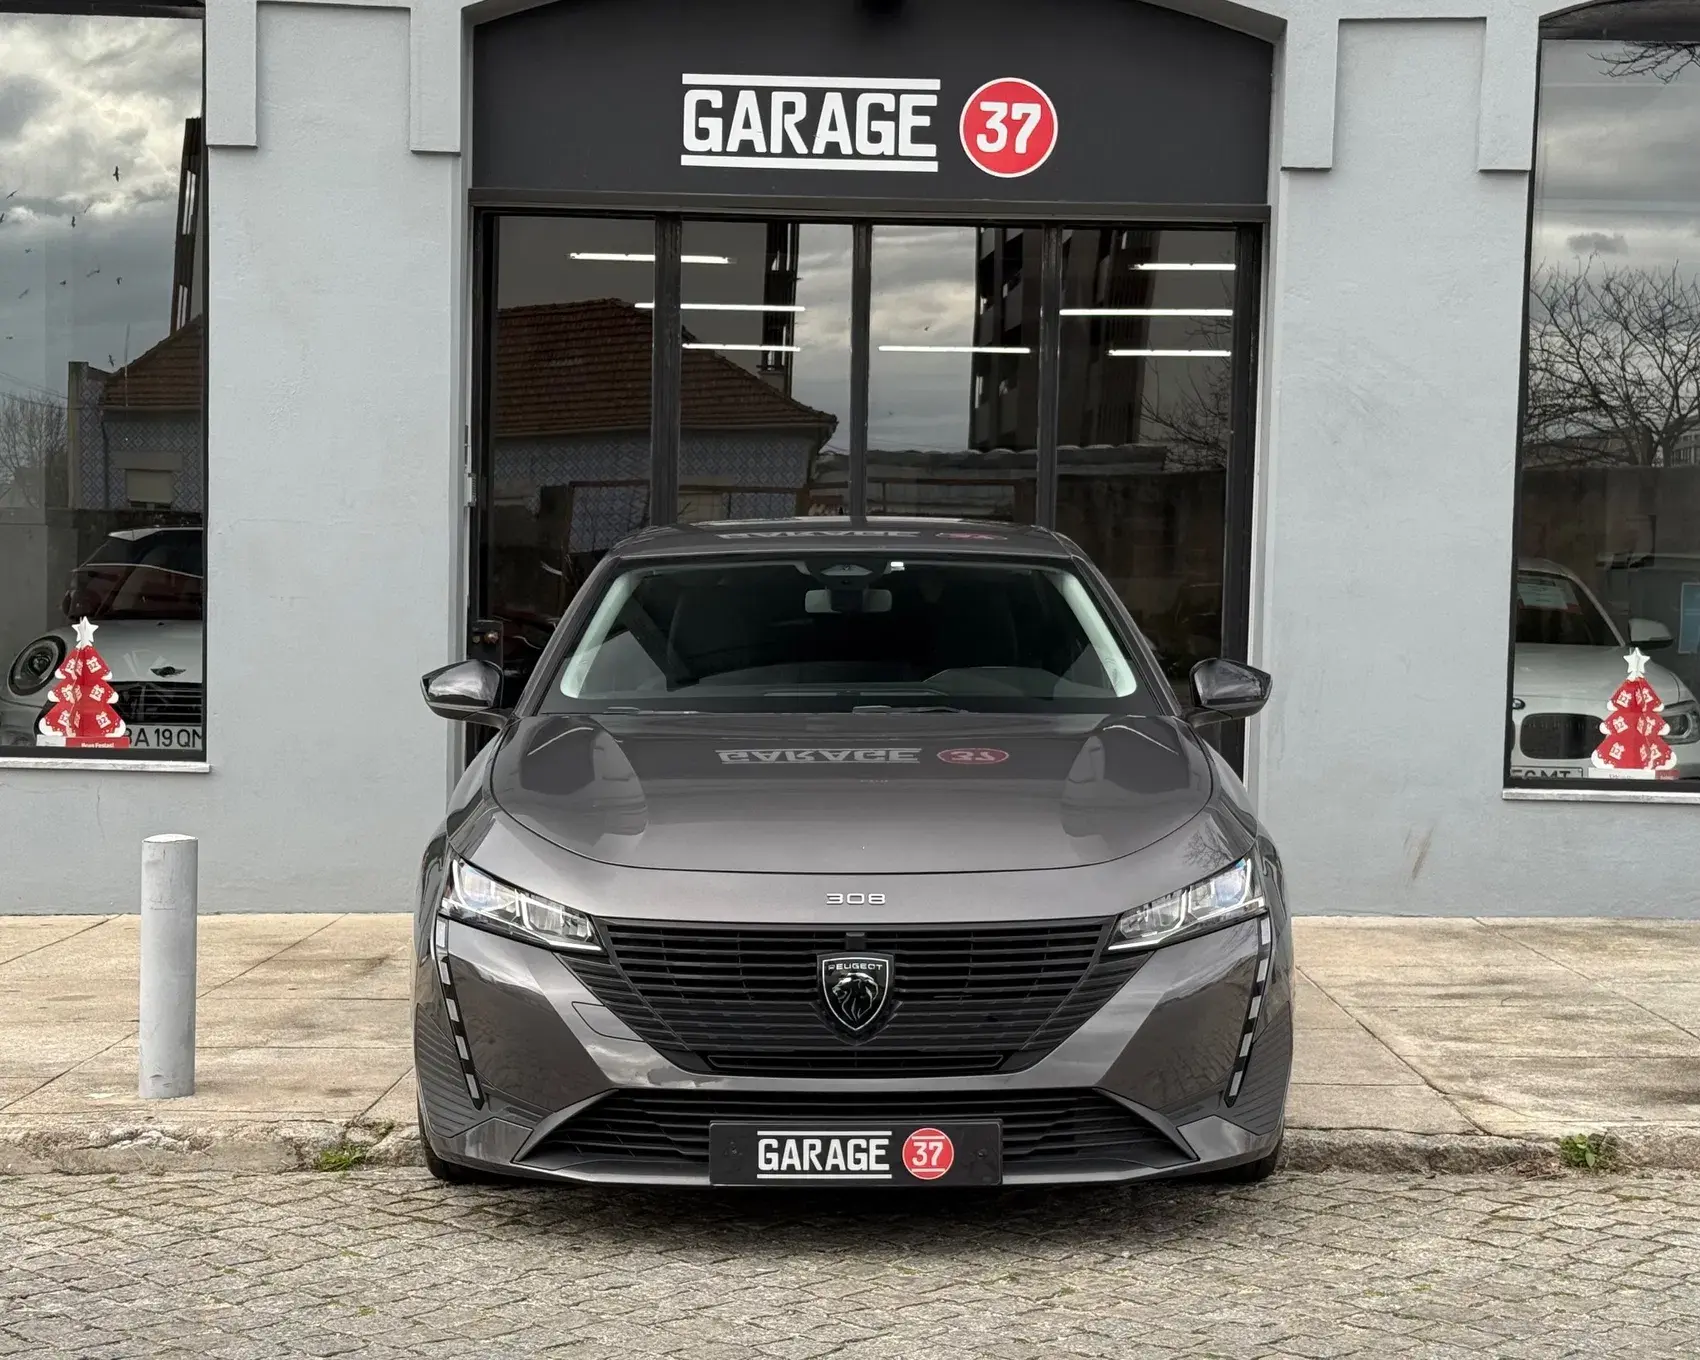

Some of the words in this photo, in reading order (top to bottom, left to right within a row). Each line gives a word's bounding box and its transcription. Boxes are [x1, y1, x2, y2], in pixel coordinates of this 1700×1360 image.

[682, 89, 939, 157] GARAGE
[976, 101, 1042, 155] 37
[154, 728, 173, 747] 19
[826, 893, 886, 905] 308
[828, 962, 883, 971] PEUGEOT
[757, 1138, 890, 1171] GARAGE
[911, 1141, 944, 1167] 37
